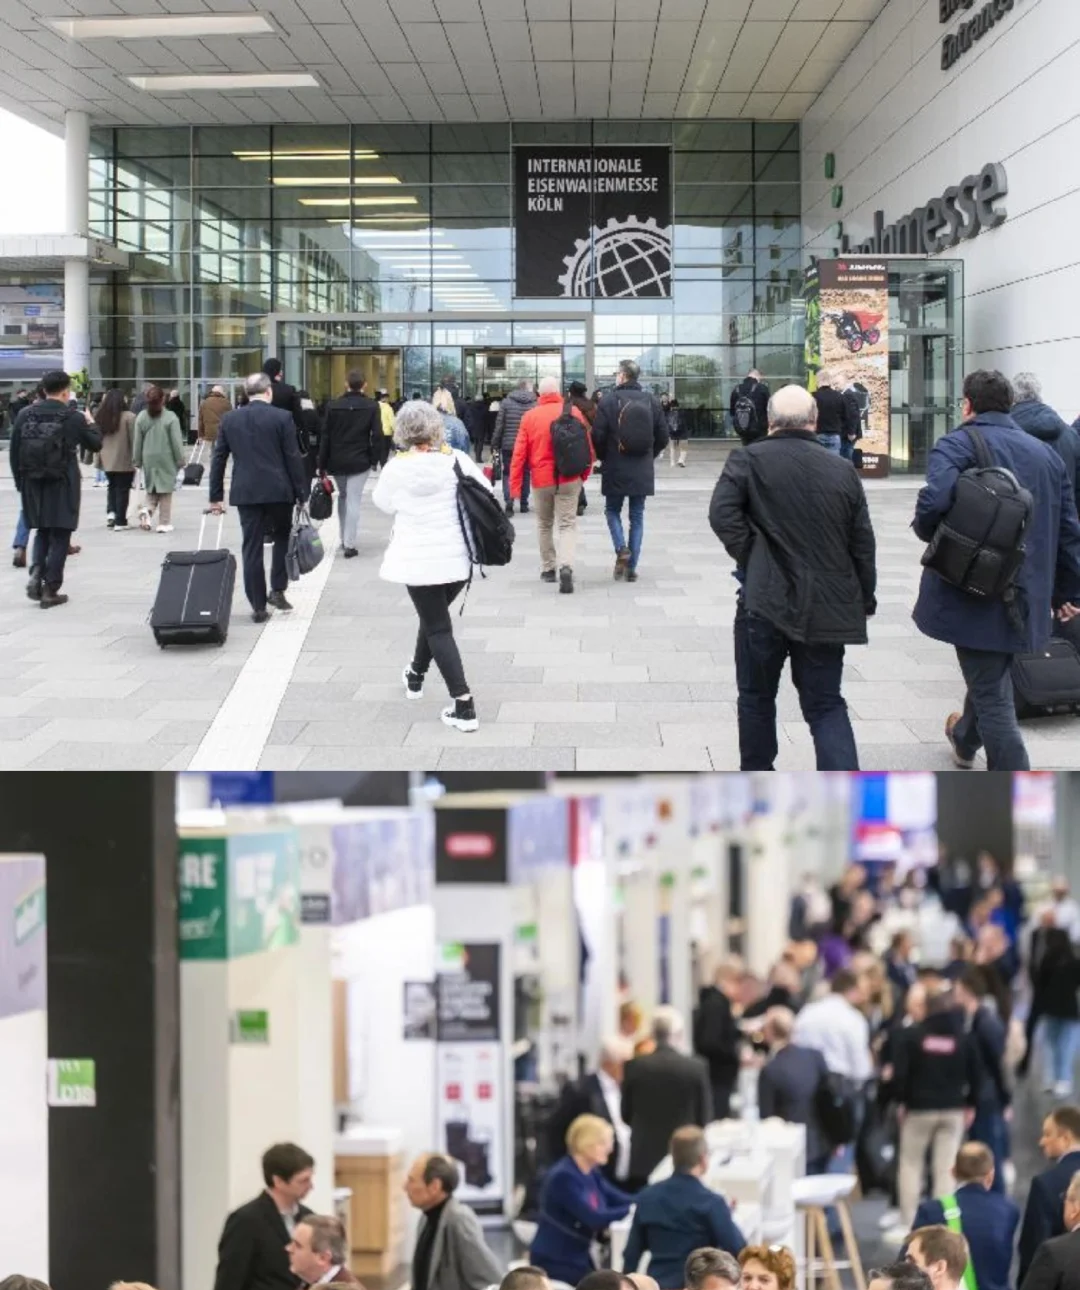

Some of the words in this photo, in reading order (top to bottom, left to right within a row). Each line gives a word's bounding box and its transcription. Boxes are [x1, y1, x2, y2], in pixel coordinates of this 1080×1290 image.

[528, 158, 642, 173] INTERNATIONALE
[528, 177, 659, 193] EISENWARENMESSE
[528, 195, 564, 212] KÖLN
